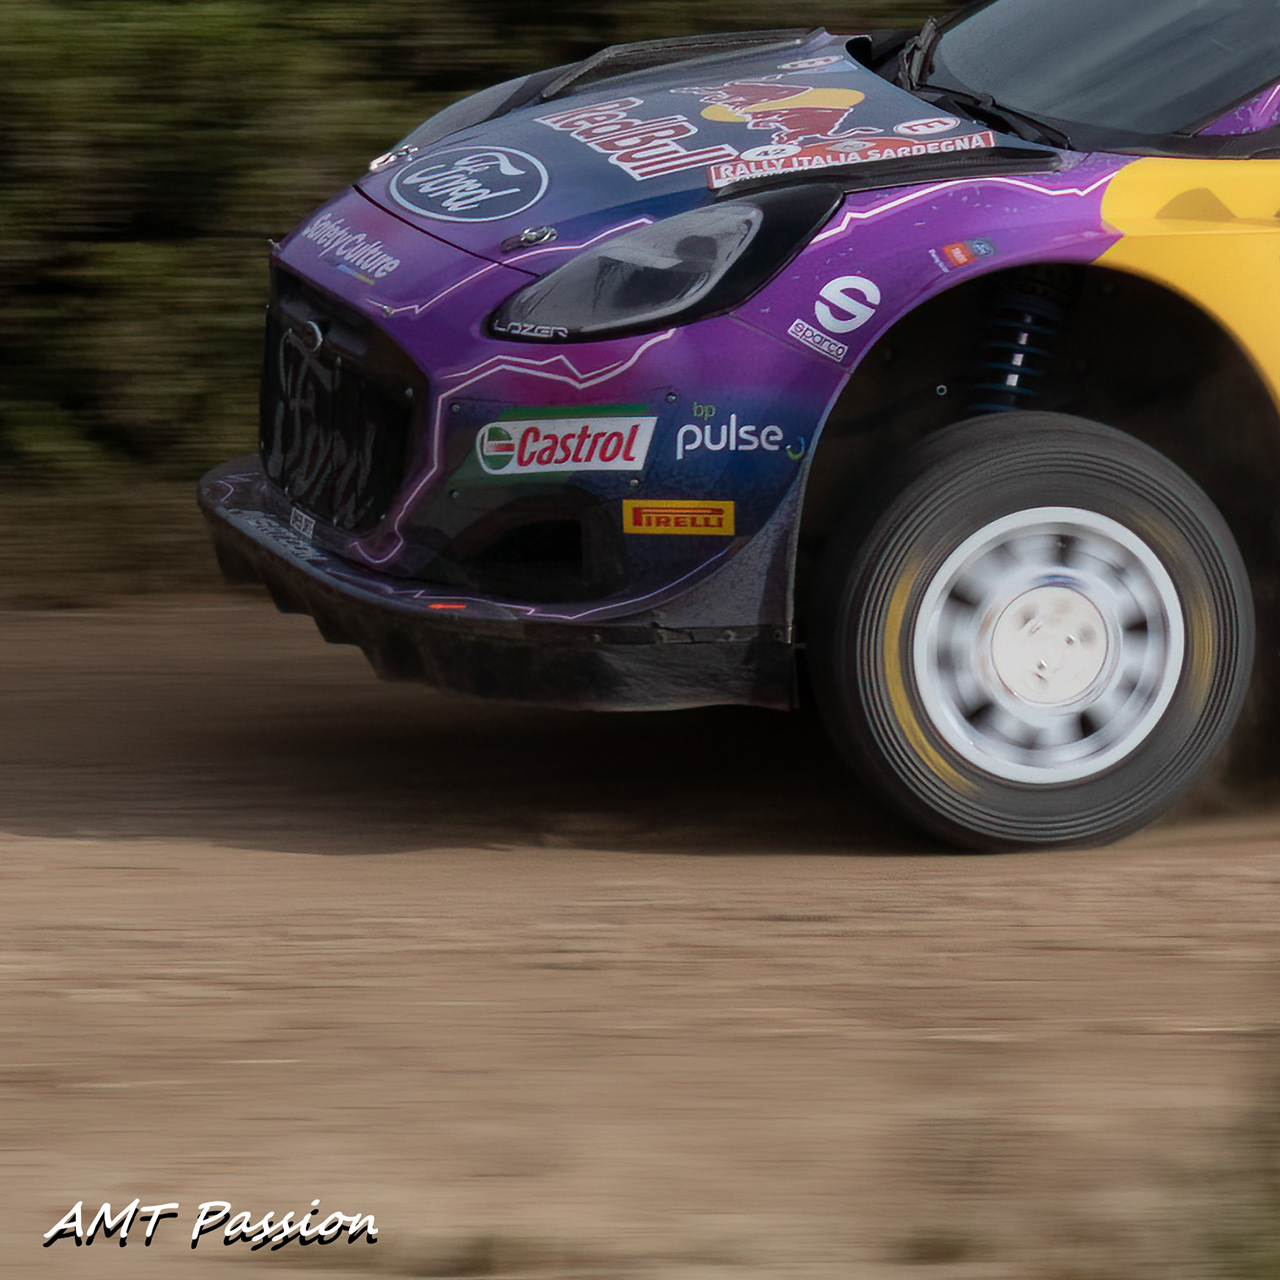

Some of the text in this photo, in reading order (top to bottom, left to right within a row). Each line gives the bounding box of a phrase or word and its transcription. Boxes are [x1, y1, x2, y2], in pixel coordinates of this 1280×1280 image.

[719, 158, 785, 180] RALLY
[792, 151, 864, 170] ITALIA
[867, 133, 987, 162] SARDEGNA
[402, 151, 526, 212] Ford
[301, 212, 401, 279] SafetyCulture
[790, 322, 846, 359] sparco
[692, 401, 716, 420] bp
[517, 423, 641, 468] Castrol
[675, 413, 784, 460] pulse
[632, 506, 725, 529] PIRELLI
